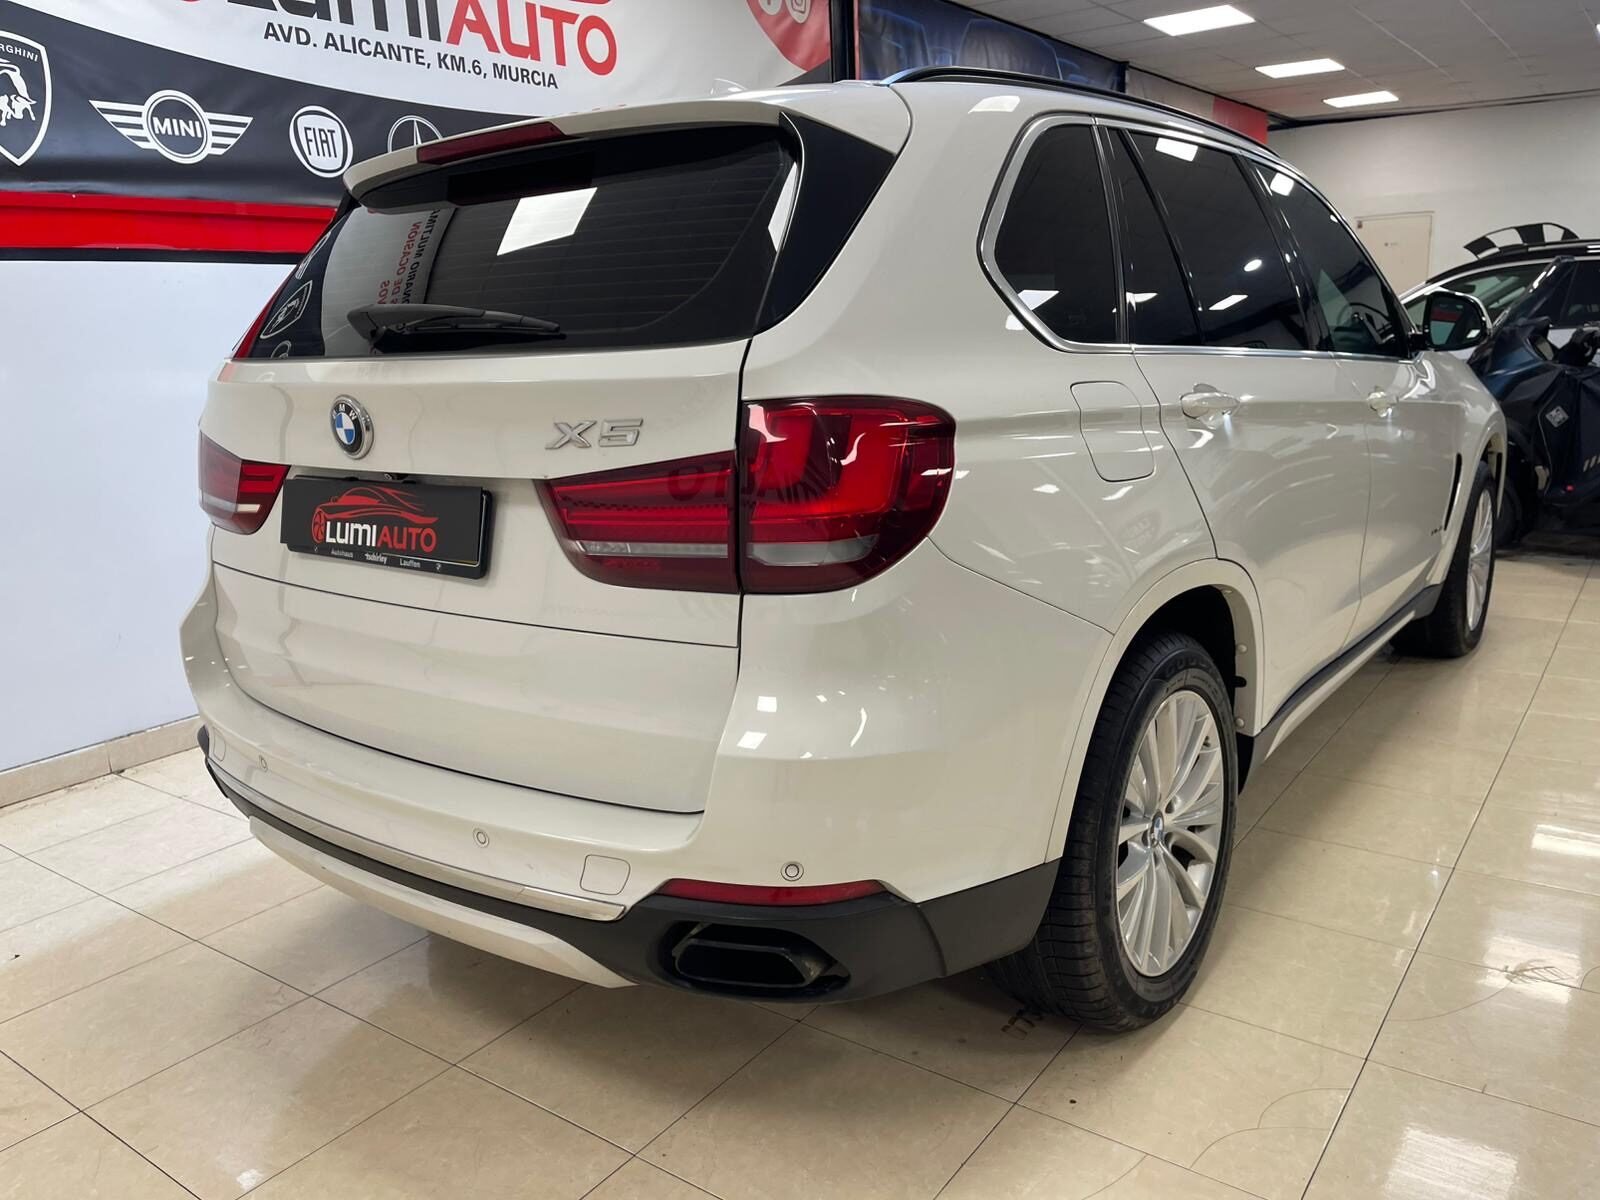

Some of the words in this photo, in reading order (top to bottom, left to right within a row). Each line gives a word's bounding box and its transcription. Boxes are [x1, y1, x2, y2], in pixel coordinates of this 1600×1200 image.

[227, 0, 617, 76] MIAUTO
[263, 22, 318, 48] AVD.
[323, 32, 431, 69] ALICANTE,
[437, 52, 488, 79] KM.6,
[492, 62, 559, 89] MURCIA
[152, 116, 203, 138] MINI
[303, 126, 338, 158] FIAT
[544, 418, 643, 449] X5
